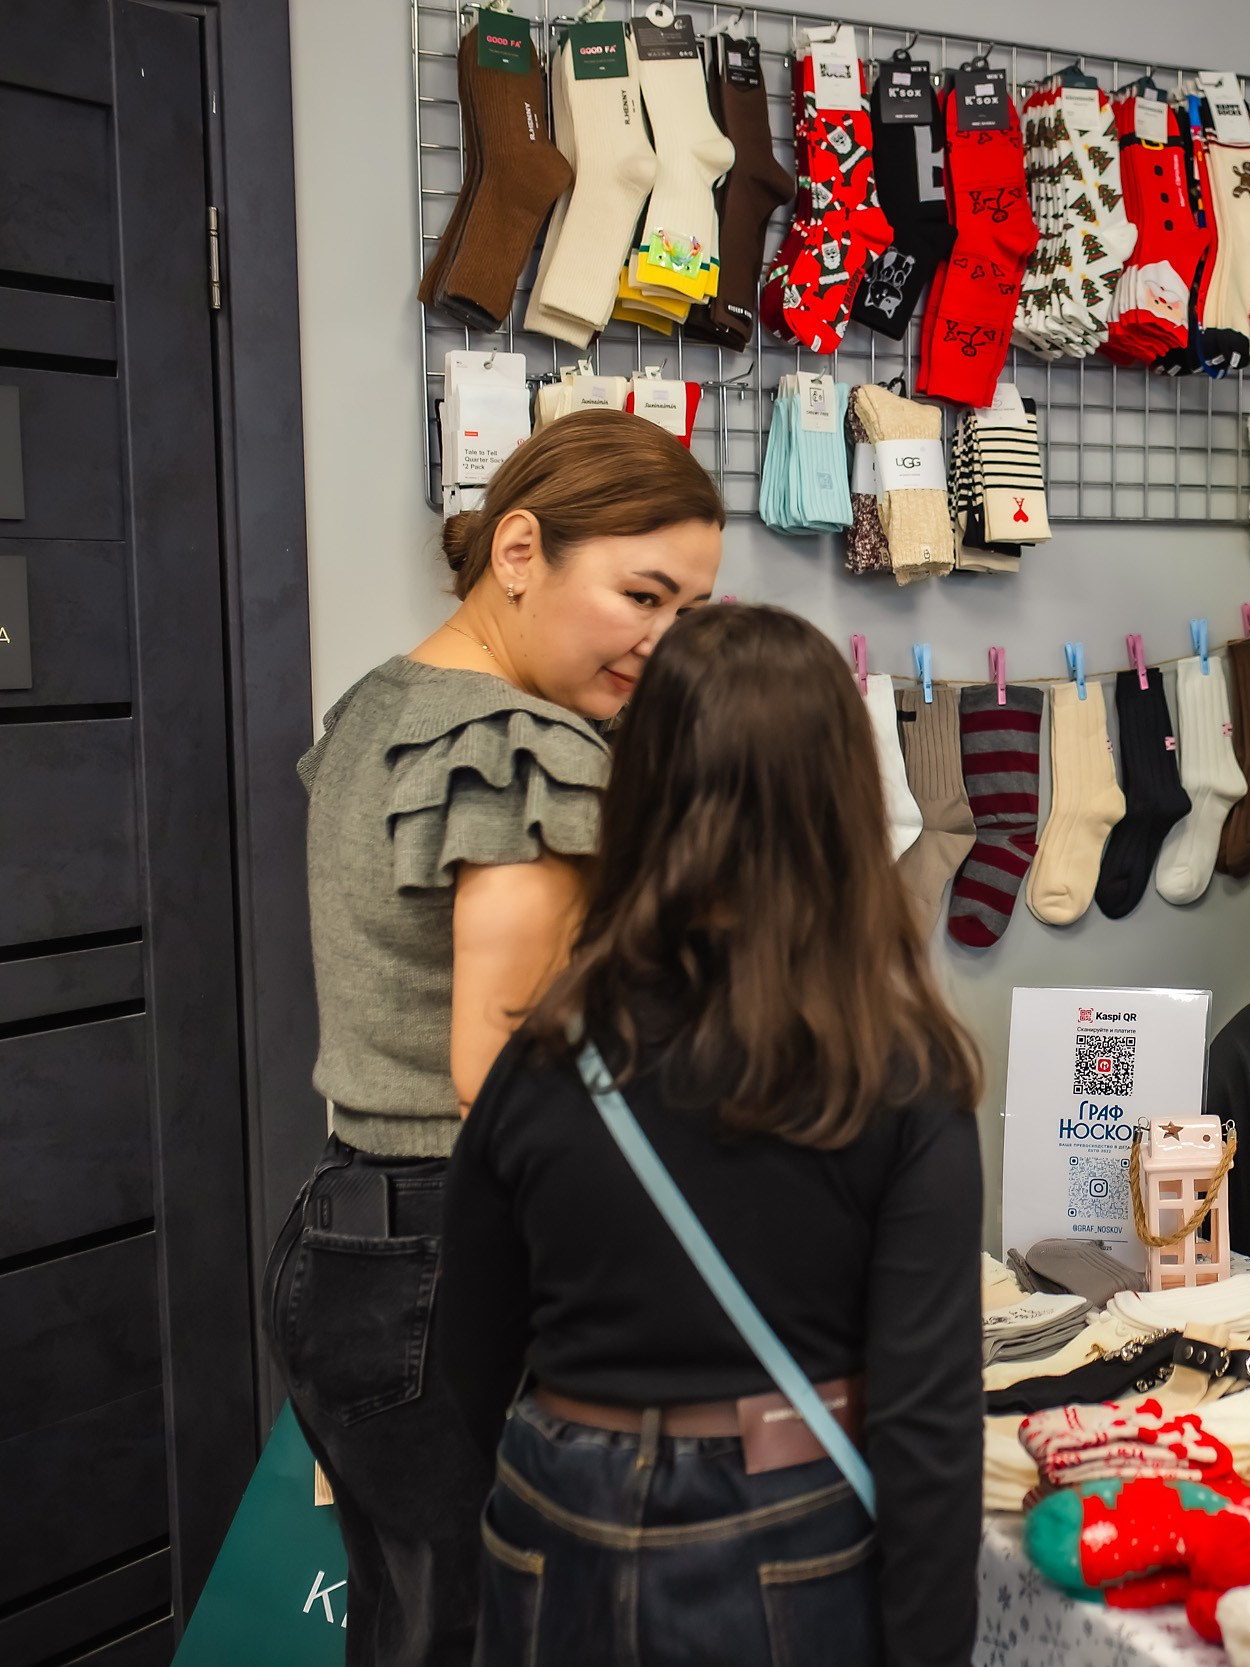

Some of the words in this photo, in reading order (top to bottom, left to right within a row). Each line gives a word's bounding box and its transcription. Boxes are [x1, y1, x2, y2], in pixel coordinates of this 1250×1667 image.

[486, 35, 509, 46] GOOD
[580, 46, 603, 55] GOOD
[464, 448, 478, 456] Tale
[486, 449, 498, 457] Tell
[895, 456, 921, 469] UGG
[1096, 1012, 1121, 1022] Kaspi
[1123, 1012, 1137, 1022] QR
[1076, 1026, 1109, 1034] Сканируйте
[1079, 1100, 1124, 1121] ГРАФ
[1072, 1224, 1123, 1234] @GRAF_NOSKOV
